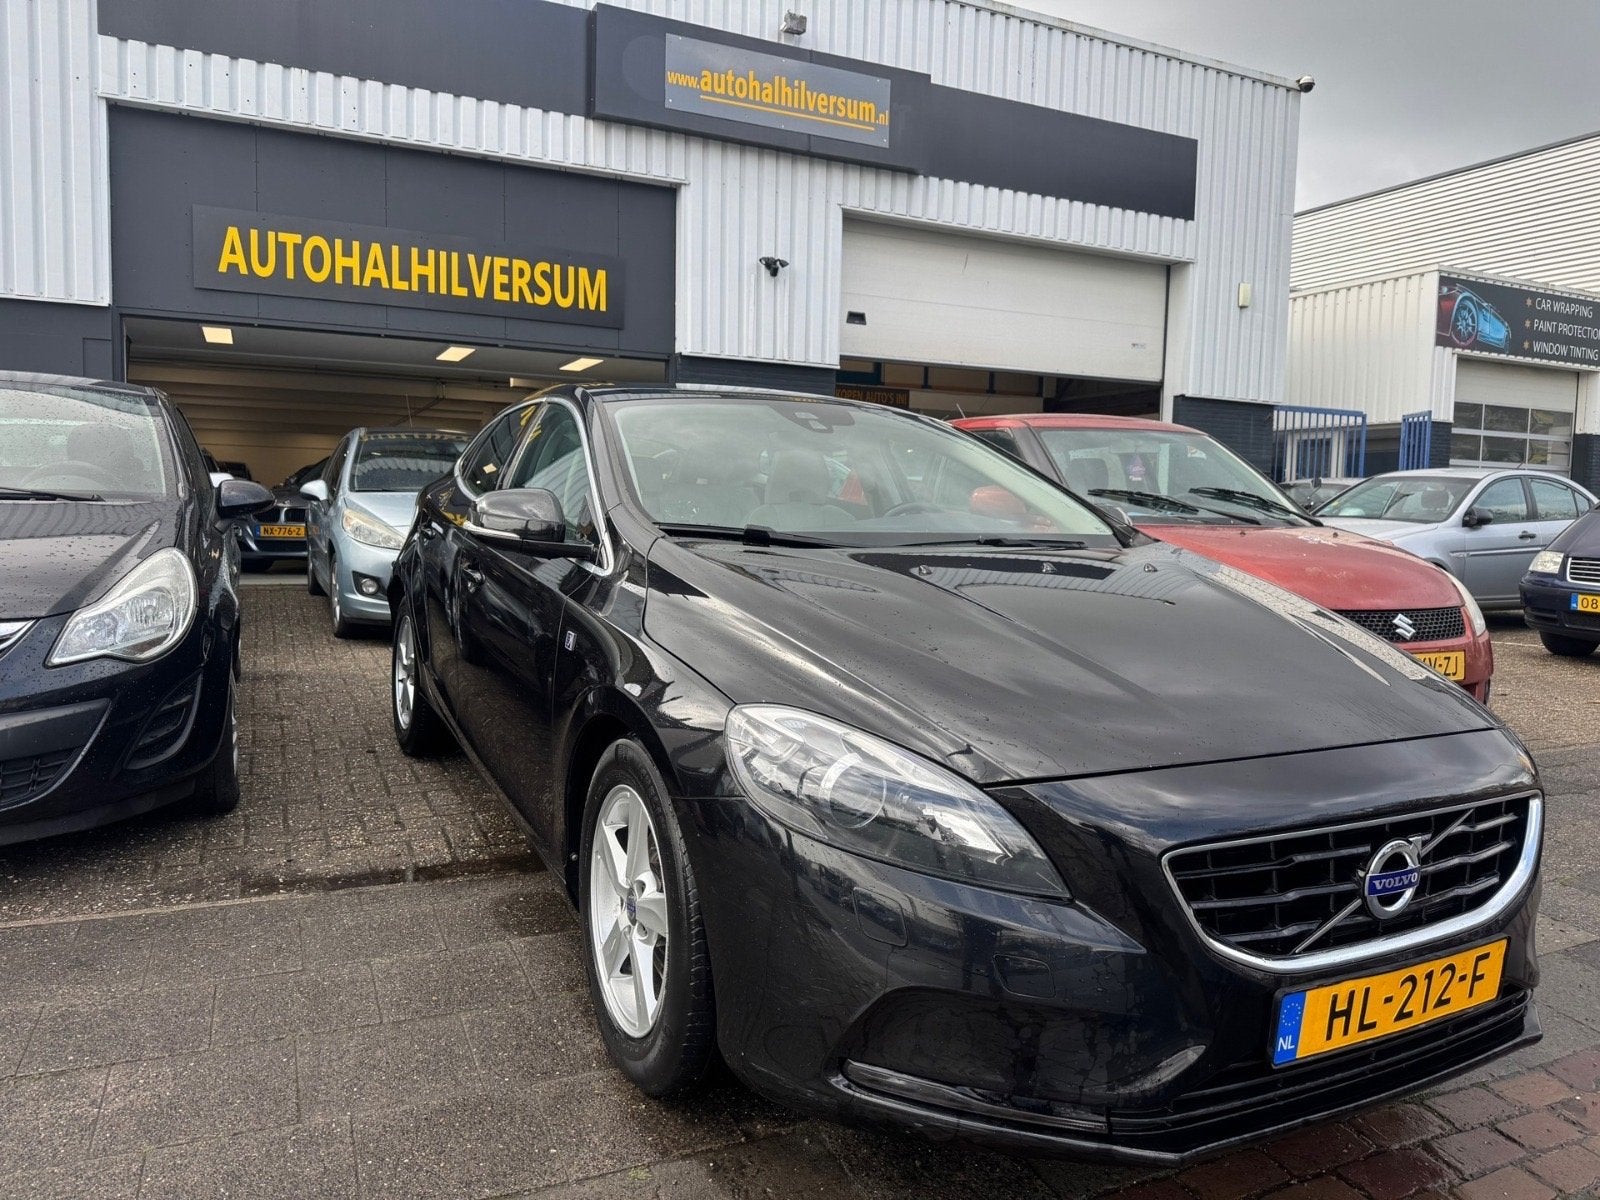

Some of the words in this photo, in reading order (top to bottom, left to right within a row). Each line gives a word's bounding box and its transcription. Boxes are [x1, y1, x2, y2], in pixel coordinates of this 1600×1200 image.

[667, 69, 889, 126] www.autohalhilversum.nl
[218, 226, 607, 312] AUTOHALHILVERSUM
[1535, 297, 1552, 311] CAR
[1553, 302, 1593, 318] WRAPPING
[1533, 319, 1557, 333] PAINT
[1533, 340, 1569, 356] WINDOW
[1570, 345, 1599, 361] TINTING
[263, 527, 302, 536] NX-776-Z
[1581, 597, 1599, 610] 08
[1373, 872, 1418, 890] VOLVO
[1277, 1034, 1295, 1051] NL
[1325, 951, 1491, 1041] HL-212-F
